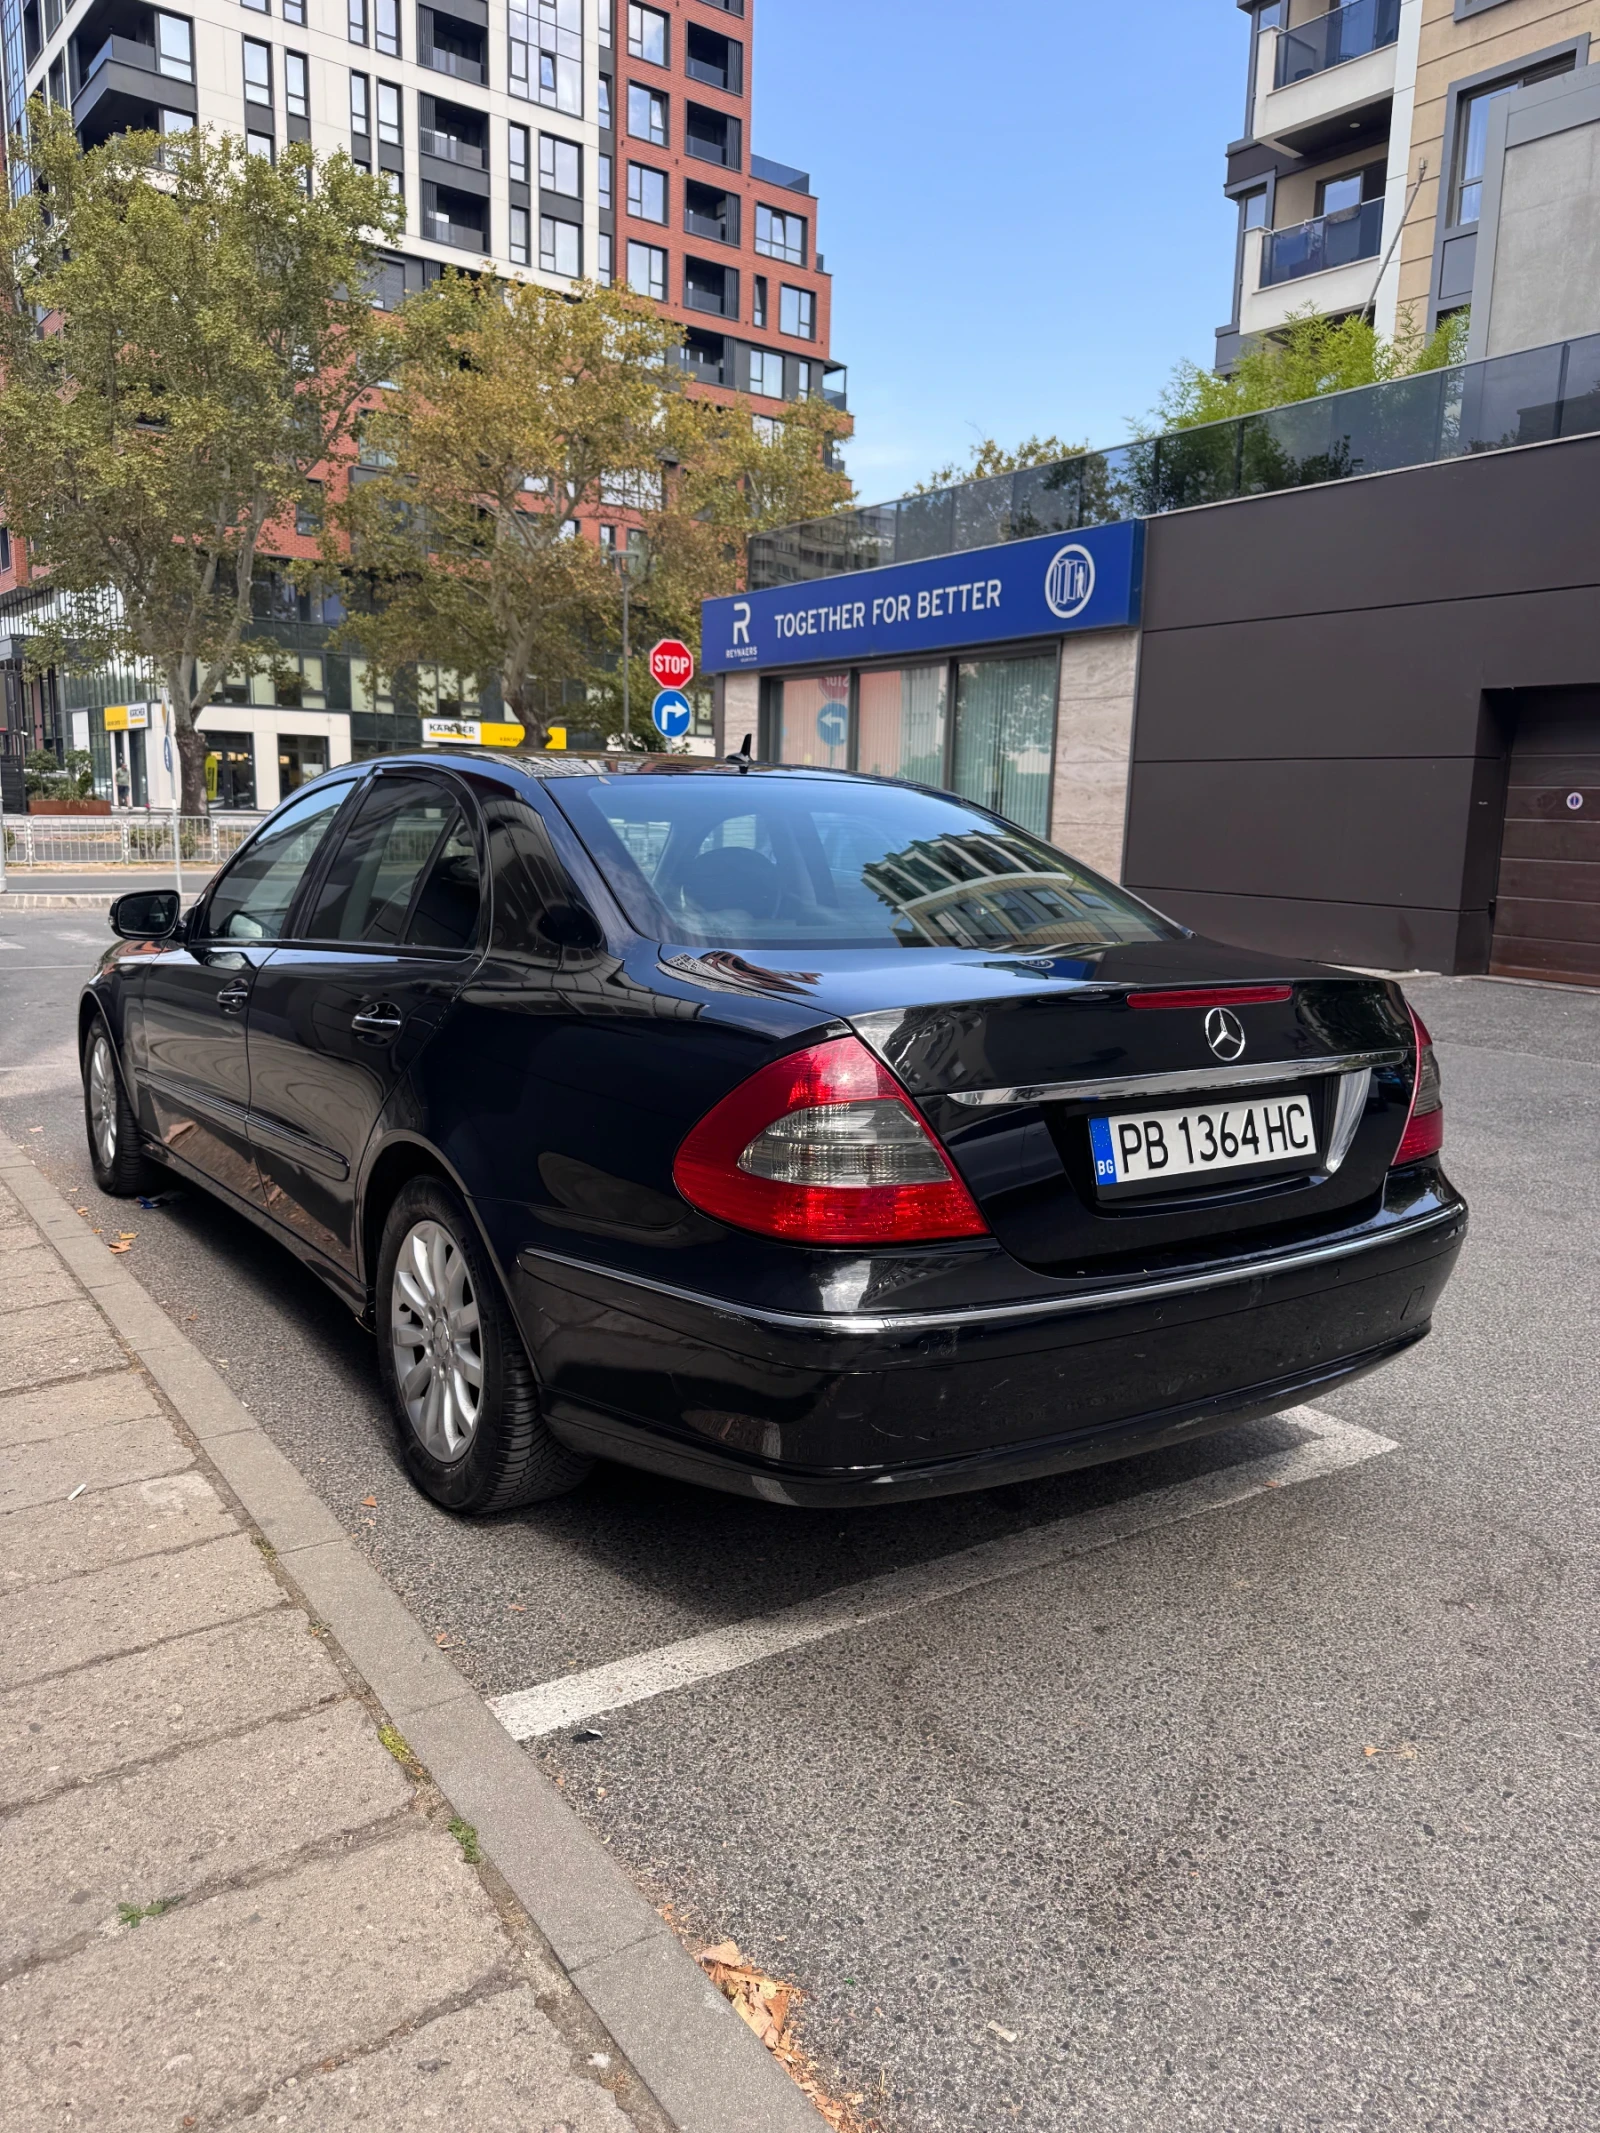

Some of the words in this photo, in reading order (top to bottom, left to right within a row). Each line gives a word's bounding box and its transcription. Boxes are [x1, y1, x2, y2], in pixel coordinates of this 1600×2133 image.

[774, 602, 866, 638] TOGETHER
[872, 594, 911, 626] FOR
[917, 579, 1002, 619] BETTER
[725, 646, 758, 658] REYNAERS
[654, 654, 690, 675] STOP
[1118, 1120, 1169, 1174] PB
[1178, 1108, 1260, 1164] 1364
[1263, 1103, 1309, 1153] HC
[1097, 1160, 1114, 1176] BG
